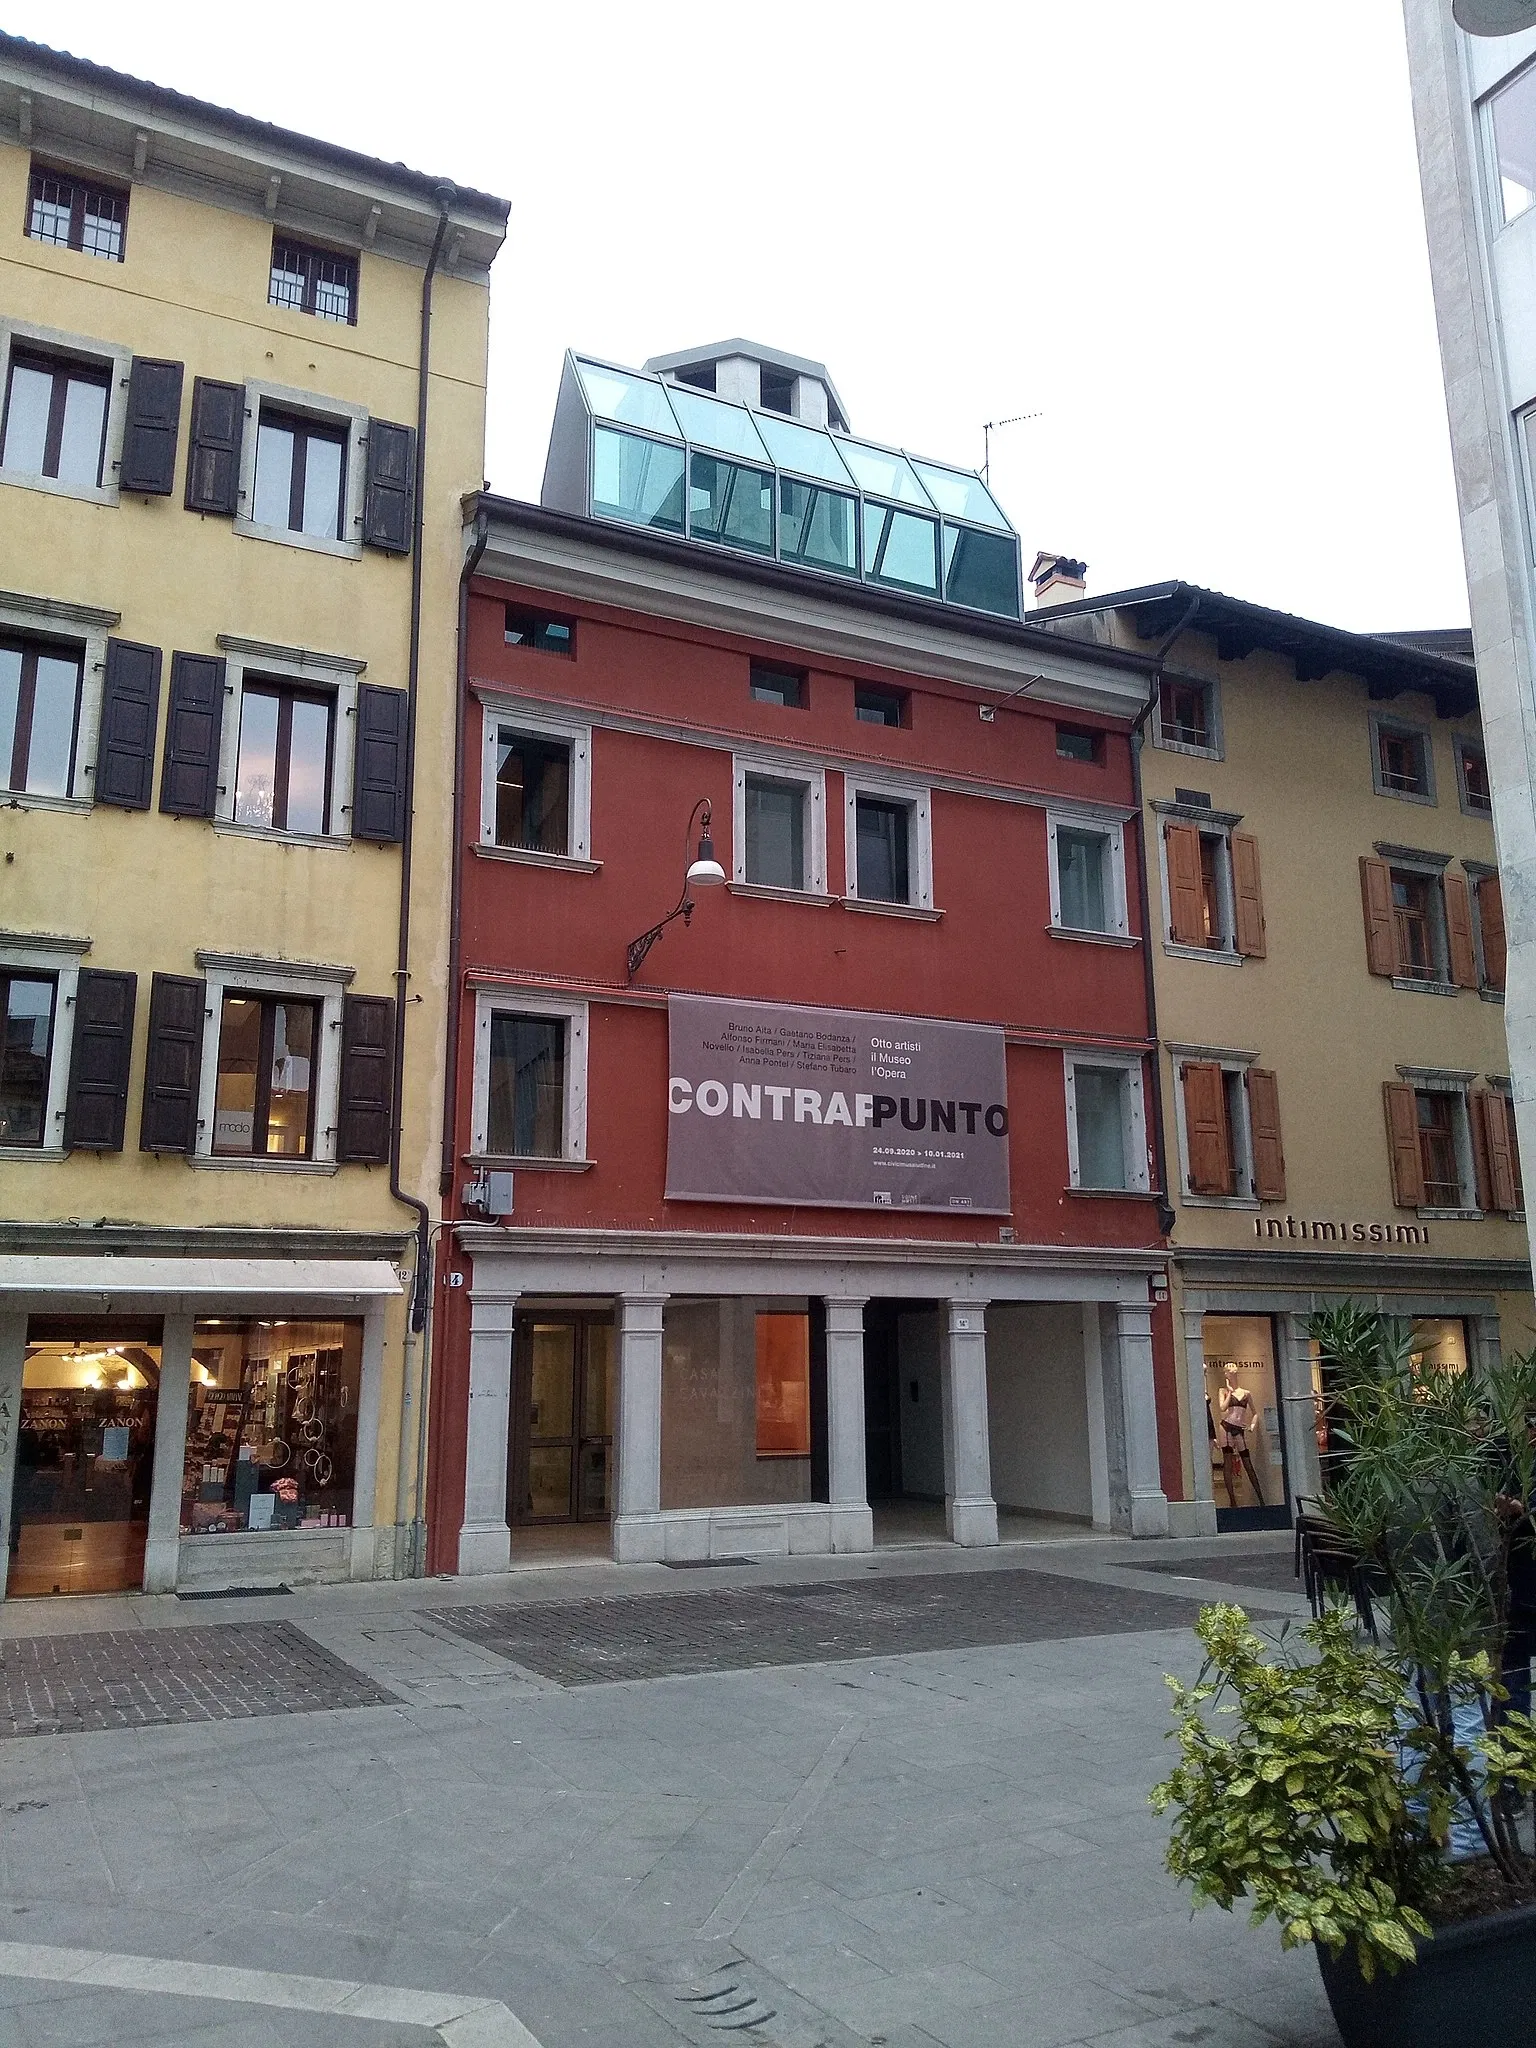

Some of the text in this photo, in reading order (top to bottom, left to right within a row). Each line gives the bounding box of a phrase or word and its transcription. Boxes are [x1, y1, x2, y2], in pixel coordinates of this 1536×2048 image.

[728, 1022, 753, 1033] Bruno
[780, 1028, 814, 1039] Gaetano
[816, 1032, 850, 1042] Bodanza
[720, 1032, 752, 1043] Alfonso
[756, 1037, 784, 1046] Firmani
[792, 1040, 816, 1050] Maria
[818, 1042, 856, 1054] Elisabetta
[871, 1037, 920, 1052] Otto artisti
[702, 1041, 734, 1052] Novello
[742, 1046, 774, 1056] Isabella
[776, 1049, 794, 1058] Pers
[802, 1052, 830, 1062] Tiziana
[832, 1054, 850, 1063] Pers
[871, 1052, 911, 1064] il Museo
[739, 1056, 760, 1066] Anna
[763, 1058, 788, 1068] Pontel
[796, 1062, 828, 1072] Stefano
[830, 1064, 856, 1074] Tubaro
[872, 1066, 906, 1079] l'Opera
[872, 1147, 915, 1156] 24.09.2020
[924, 1150, 964, 1158] 10.01.2021
[1254, 1215, 1429, 1244] intimissimi
[20, 1419, 68, 1430] ZANON
[98, 1418, 144, 1428] ZANON
